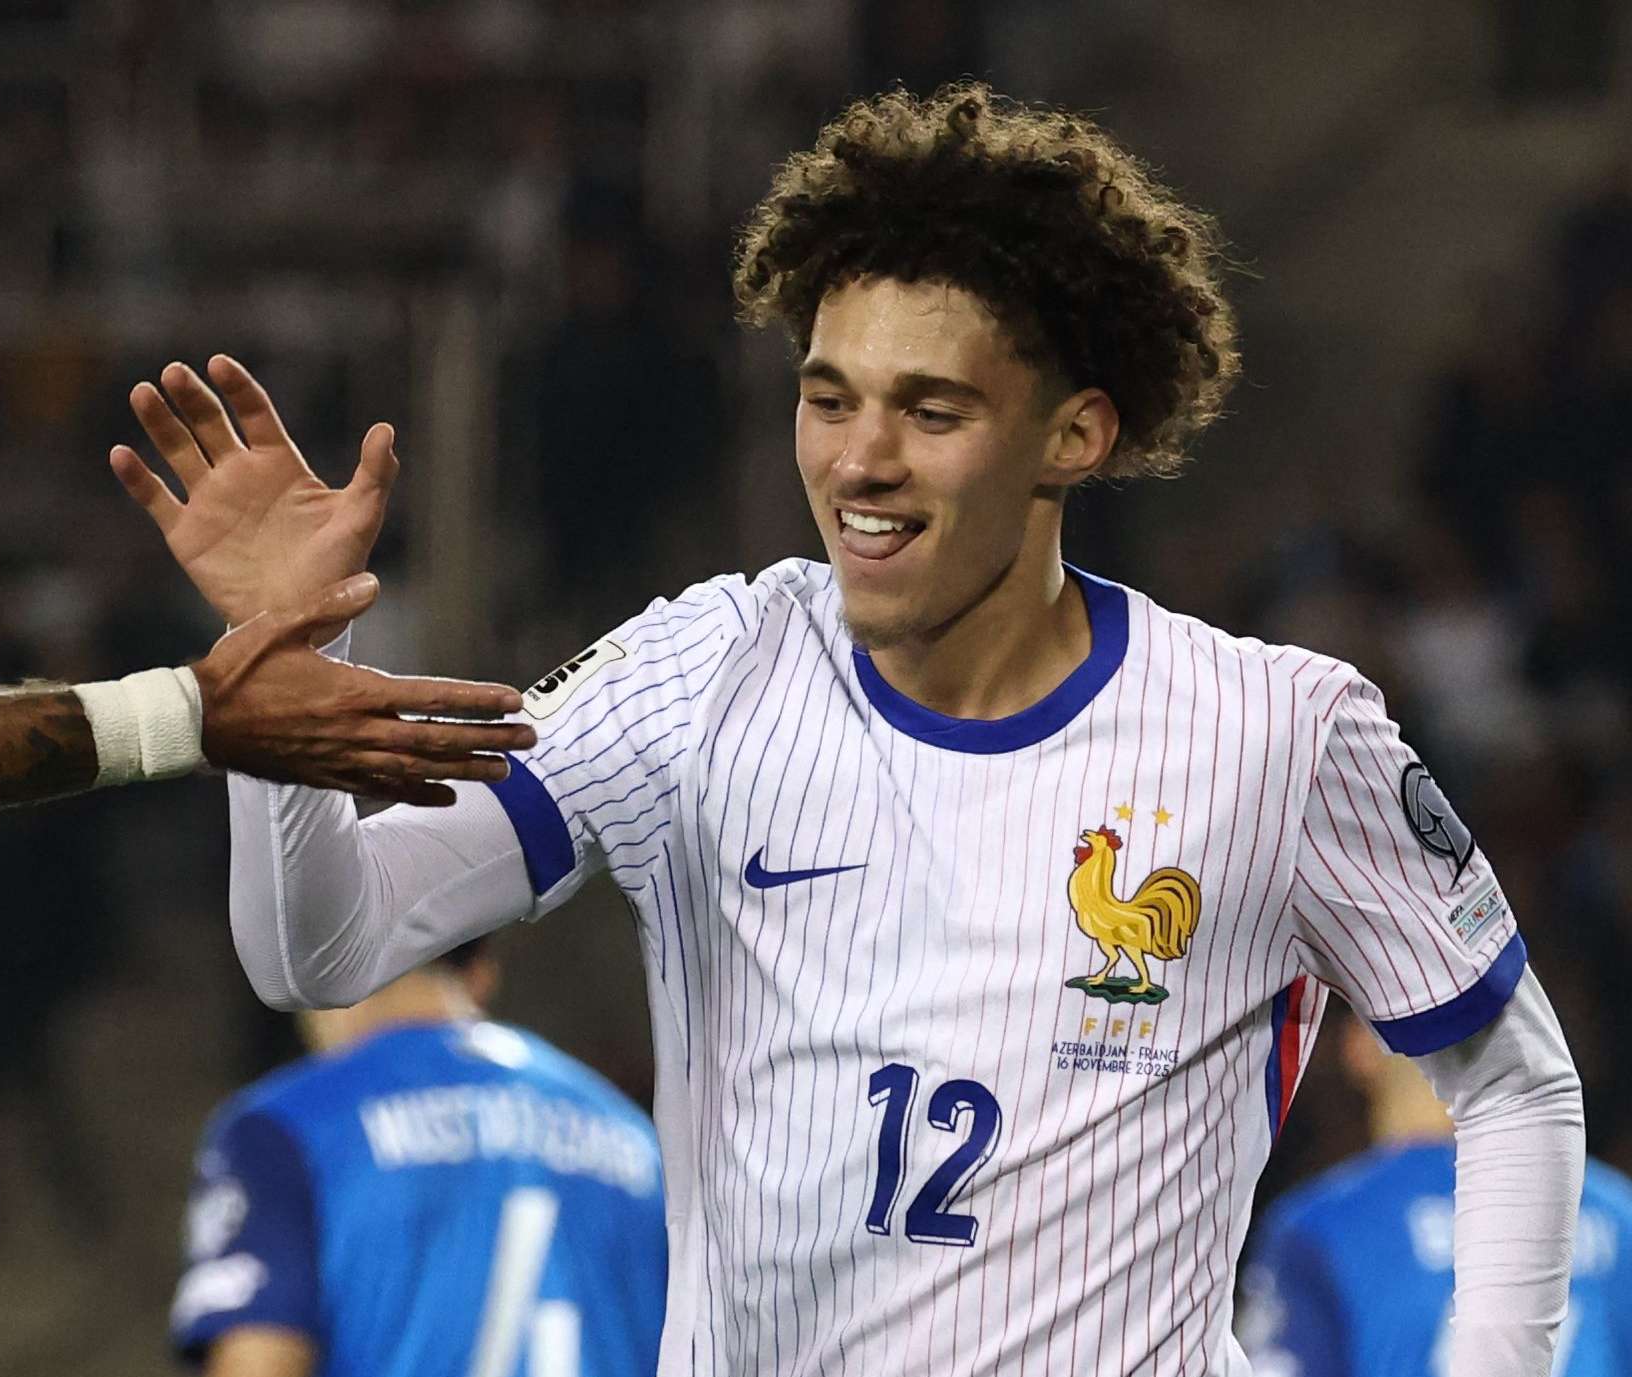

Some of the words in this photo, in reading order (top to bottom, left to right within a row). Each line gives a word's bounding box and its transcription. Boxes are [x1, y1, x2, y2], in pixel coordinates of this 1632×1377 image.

[1138, 1046, 1179, 1063] FRANCE
[1057, 1056, 1069, 1070] 16
[1073, 1058, 1131, 1074] NOVEMBRE
[1136, 1061, 1171, 1078] 2025
[866, 1062, 1004, 1248] 12
